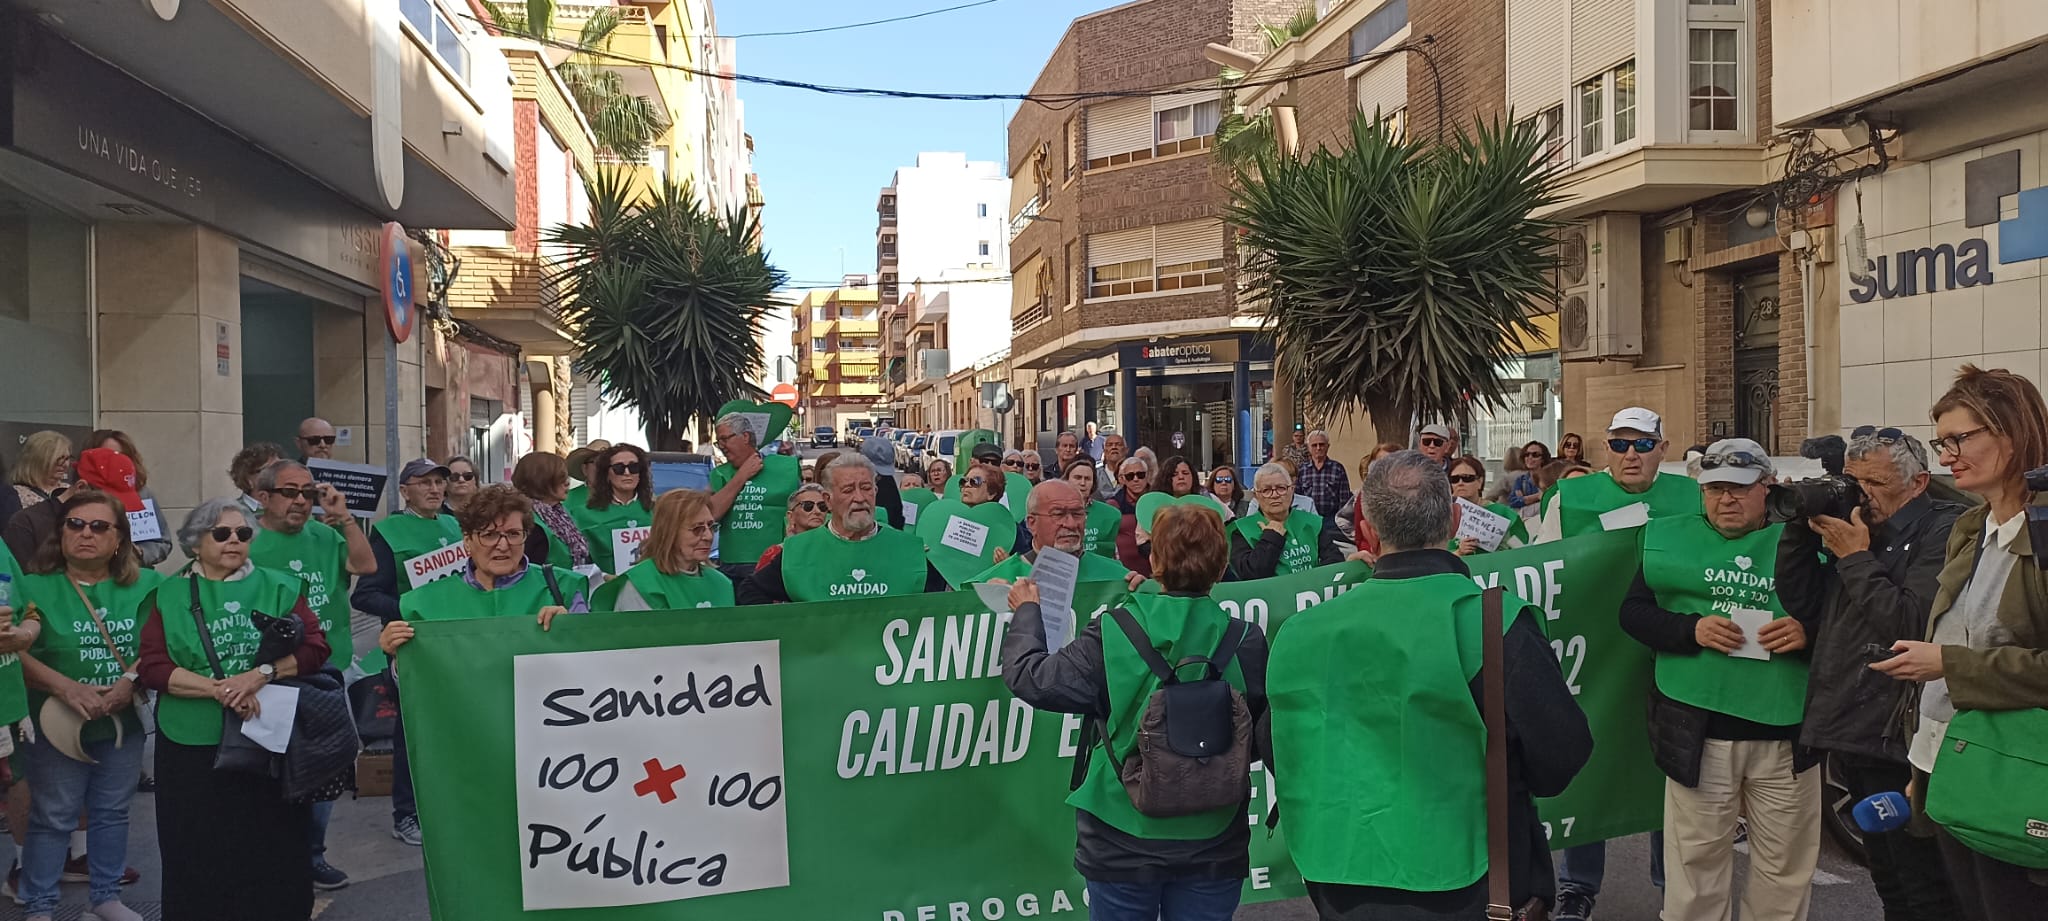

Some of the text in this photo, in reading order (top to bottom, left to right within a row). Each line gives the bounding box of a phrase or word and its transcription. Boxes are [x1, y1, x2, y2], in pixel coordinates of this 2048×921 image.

[78, 125, 110, 160] UNA
[115, 143, 147, 176] VIDA
[152, 159, 177, 189] QUE
[340, 224, 381, 258] VISSU
[1849, 238, 1993, 303] suma
[1760, 300, 1773, 315] 28
[347, 475, 373, 483] demora
[731, 521, 764, 530] CALIDAD
[745, 512, 755, 520] DE
[829, 582, 889, 597] SANIDAD
[1513, 559, 1564, 621] DE
[1709, 586, 1735, 597] 100
[79, 633, 133, 645] 100 100
[211, 632, 233, 648] 100
[106, 661, 121, 674] DE
[543, 663, 772, 727] Sanidad
[836, 697, 1034, 779] CALIDAD
[538, 753, 619, 793] 100
[708, 772, 782, 811] 100
[527, 813, 728, 887] Pública
[882, 889, 1090, 921] DEROGA
